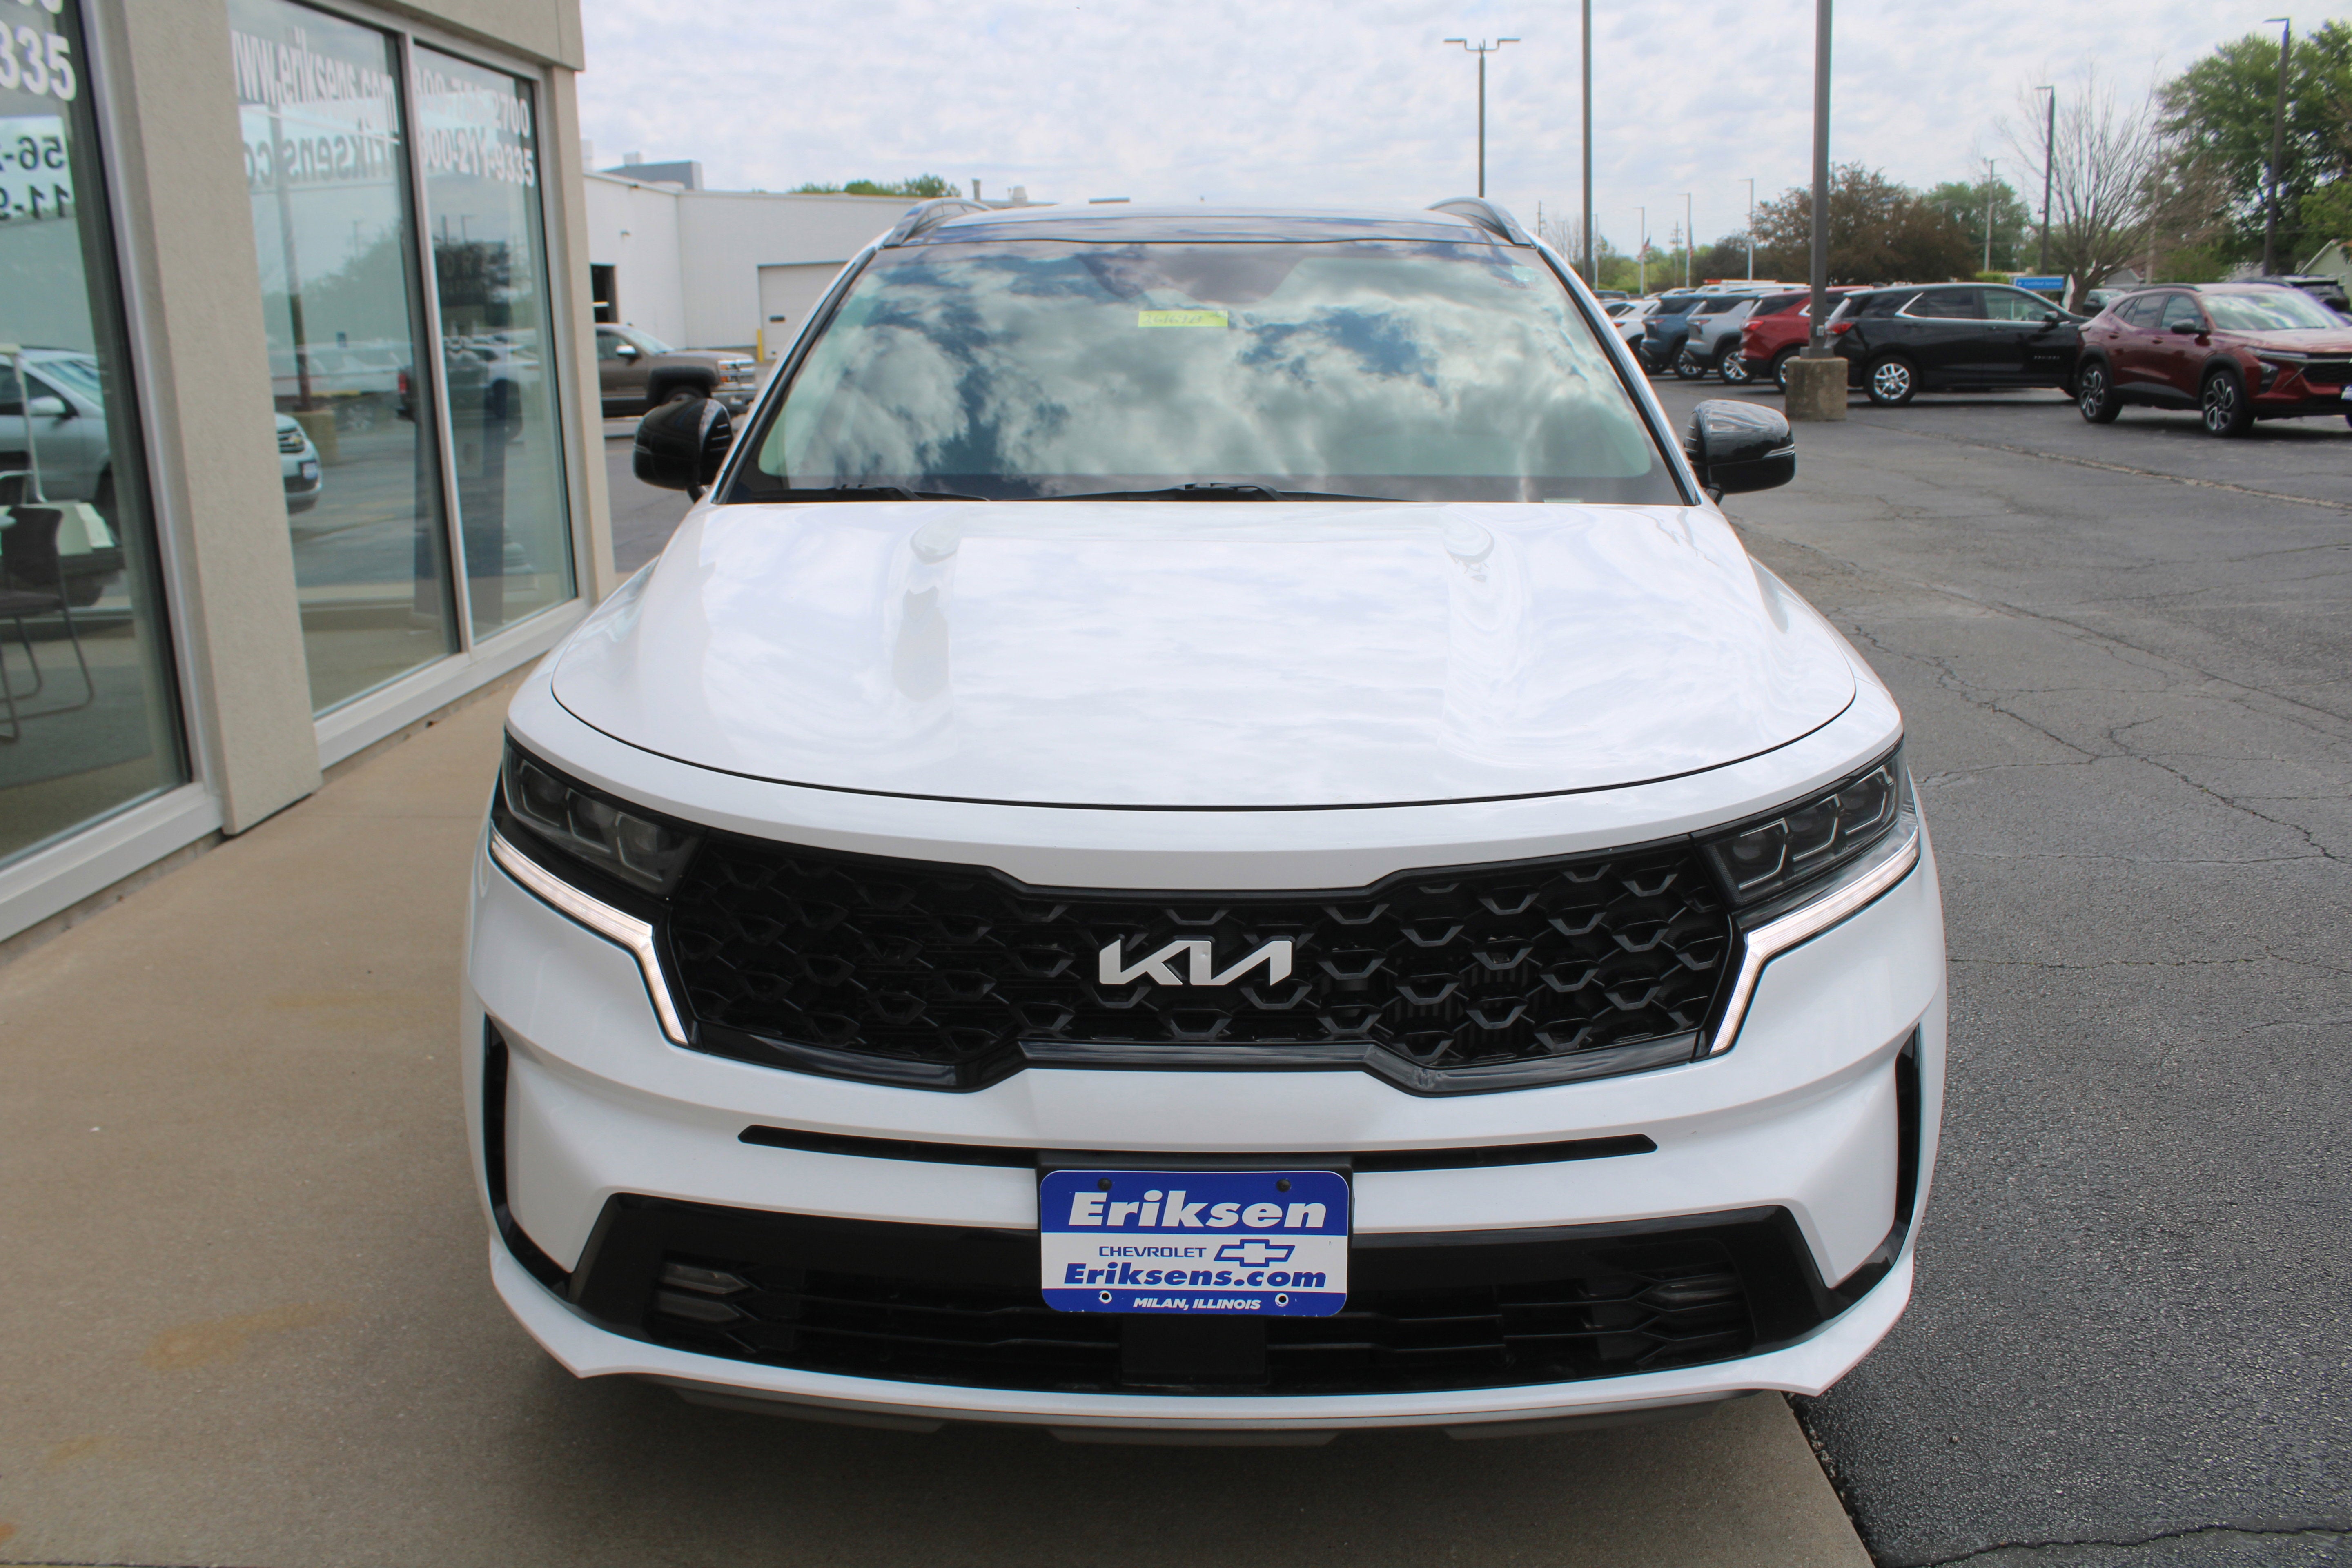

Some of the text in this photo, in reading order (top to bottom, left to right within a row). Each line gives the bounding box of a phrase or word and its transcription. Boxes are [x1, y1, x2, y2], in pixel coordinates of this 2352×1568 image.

[1099, 939, 1292, 986] KIA
[1068, 1189, 1327, 1228] Eriksen
[1099, 1246, 1207, 1258] CHEVROLET
[1064, 1262, 1326, 1288] Eriksens.com
[1133, 1298, 1262, 1310] MILAN, ILLINOIS
